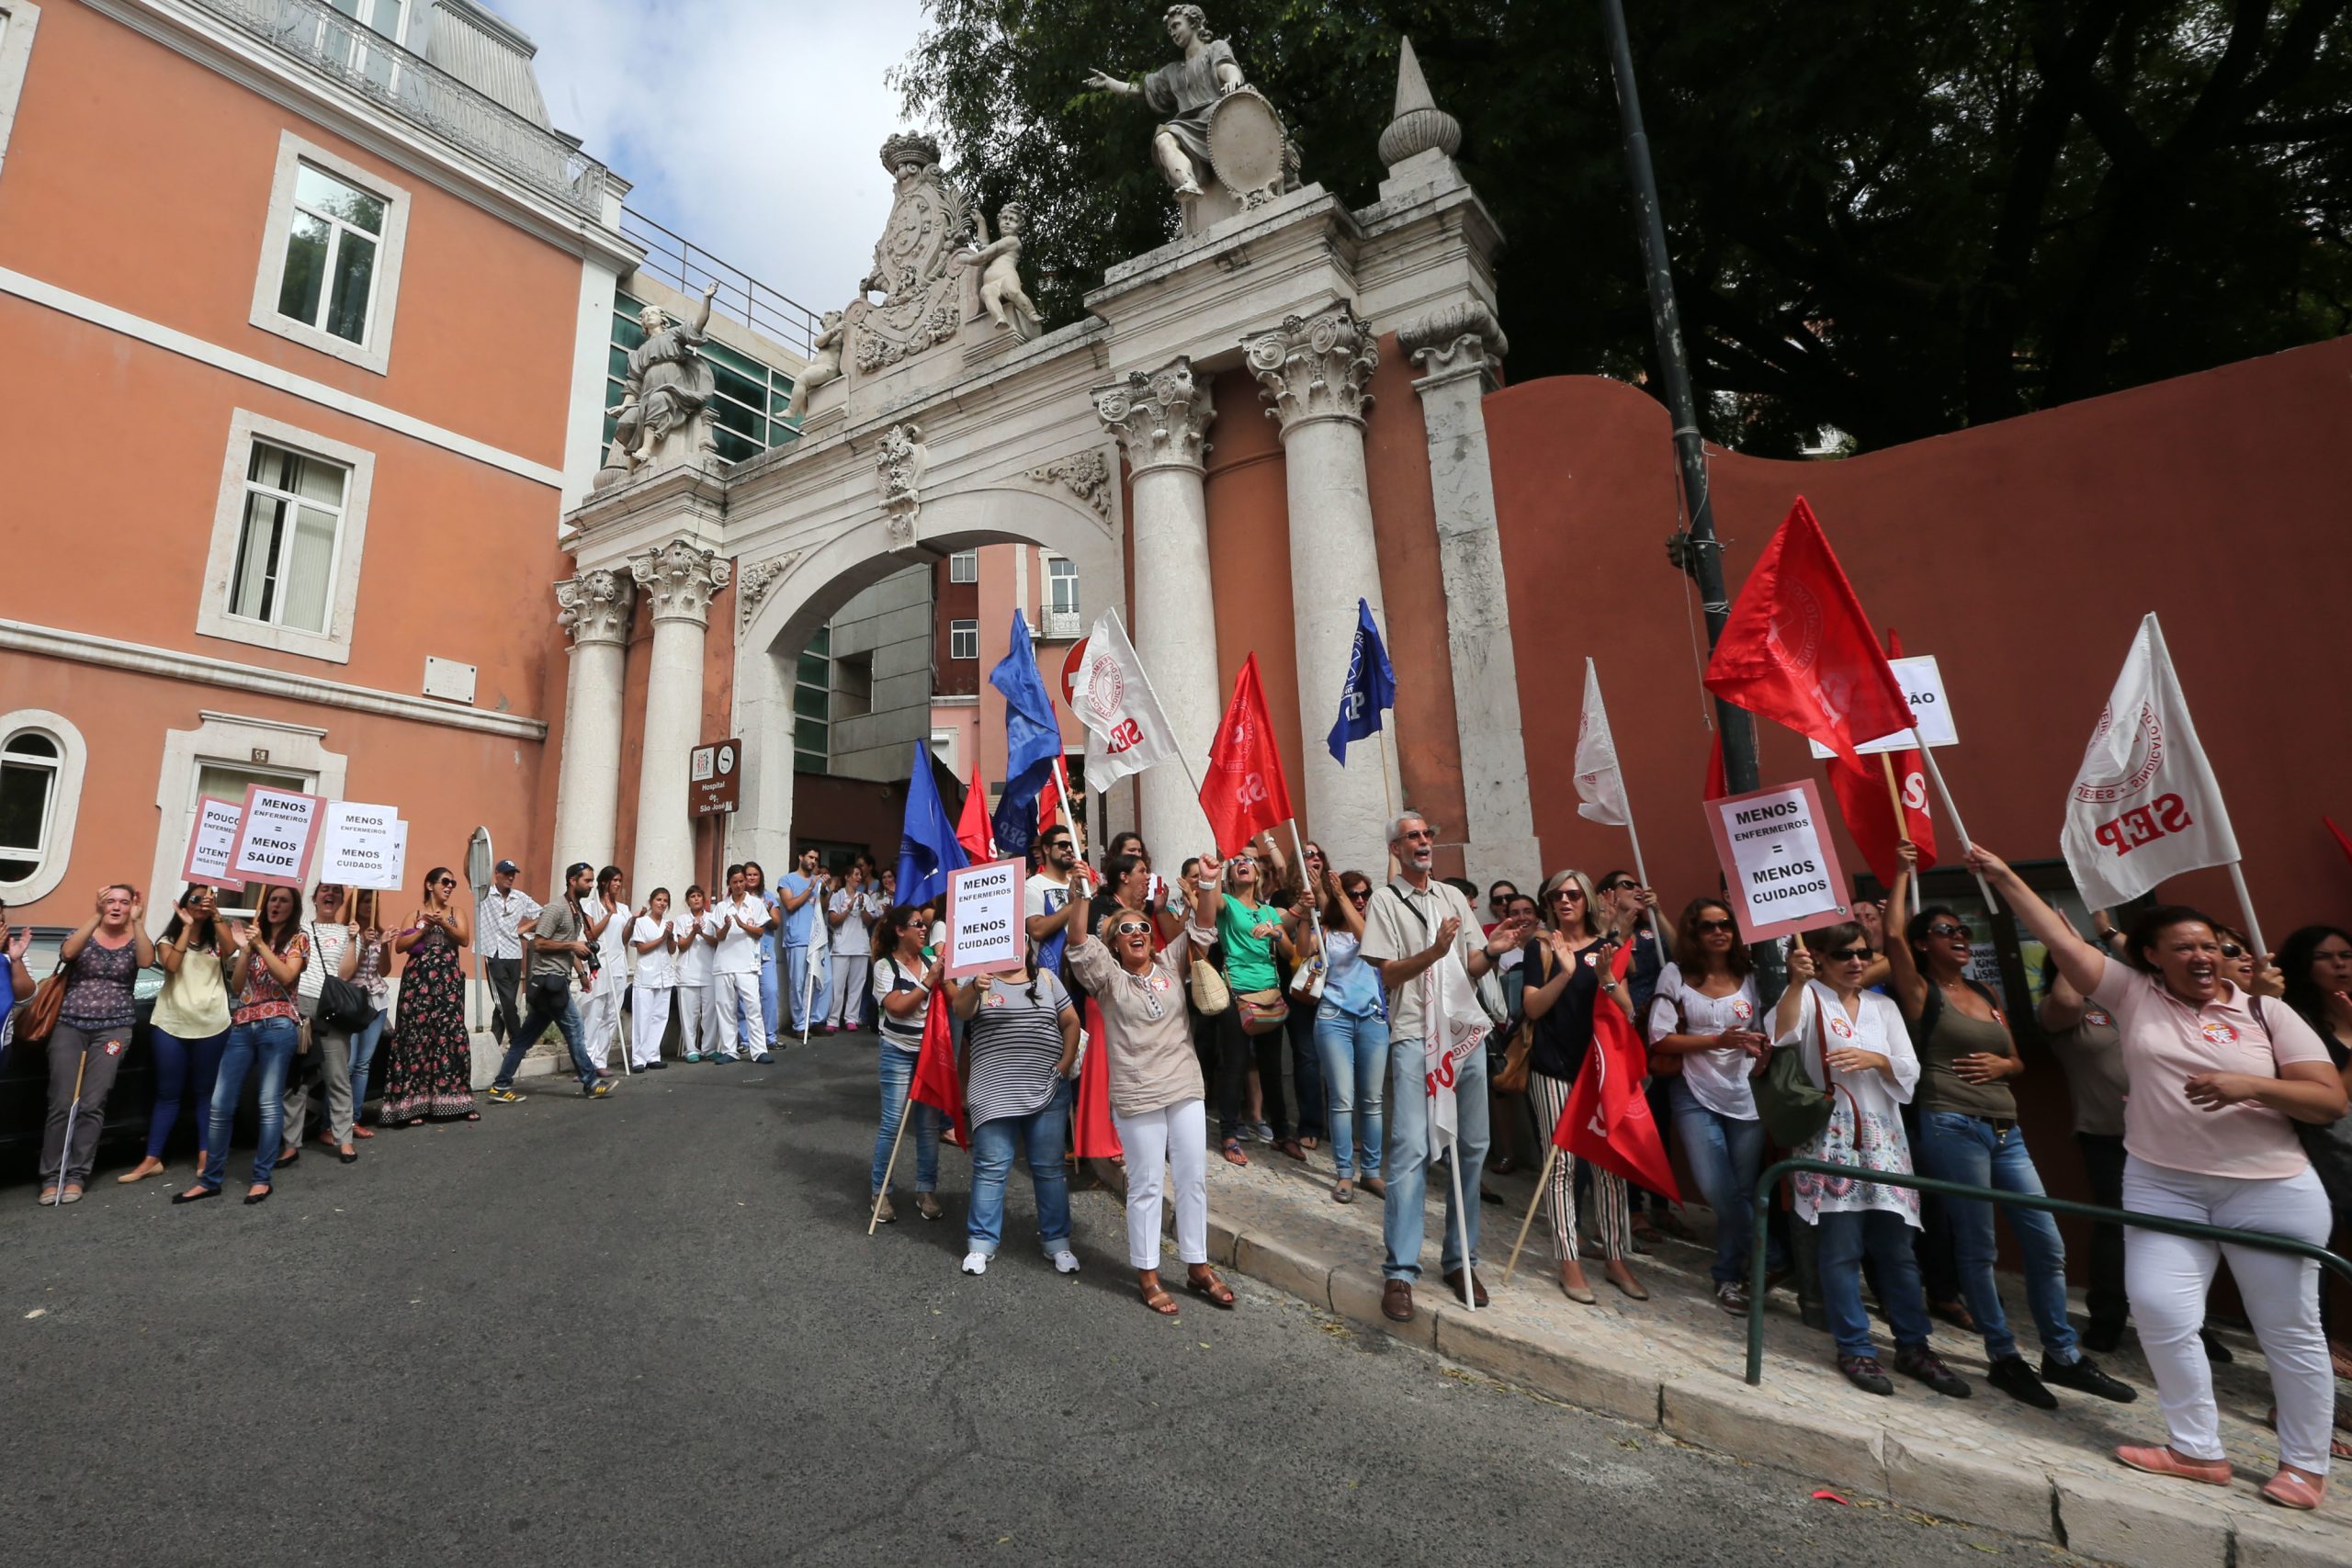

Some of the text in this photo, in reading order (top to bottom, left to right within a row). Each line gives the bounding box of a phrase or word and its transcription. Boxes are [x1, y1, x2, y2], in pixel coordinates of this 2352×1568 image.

[702, 781, 725, 791] Hospital
[262, 798, 307, 813] MENOS
[699, 805, 711, 813] São
[1736, 801, 1798, 825] MENOS
[254, 809, 309, 824] ENFERMEIROS
[345, 815, 383, 826] MENOS
[340, 826, 387, 835] ENFERMEIROS
[1734, 819, 1809, 841] ENFERMEIROS
[251, 837, 297, 852] MENOS
[198, 846, 230, 859] UTENT
[247, 852, 295, 867] SAÚDE
[342, 849, 379, 859] MENOS
[336, 860, 382, 870] CUIDADOS
[1752, 860, 1815, 885] MENOS
[964, 874, 1007, 890] MENOS
[958, 887, 1012, 903] ENFERMEIROS
[1753, 879, 1826, 904] CUIDADOS
[962, 919, 1006, 935] MENOS
[957, 934, 1011, 951] CUIDADOS
